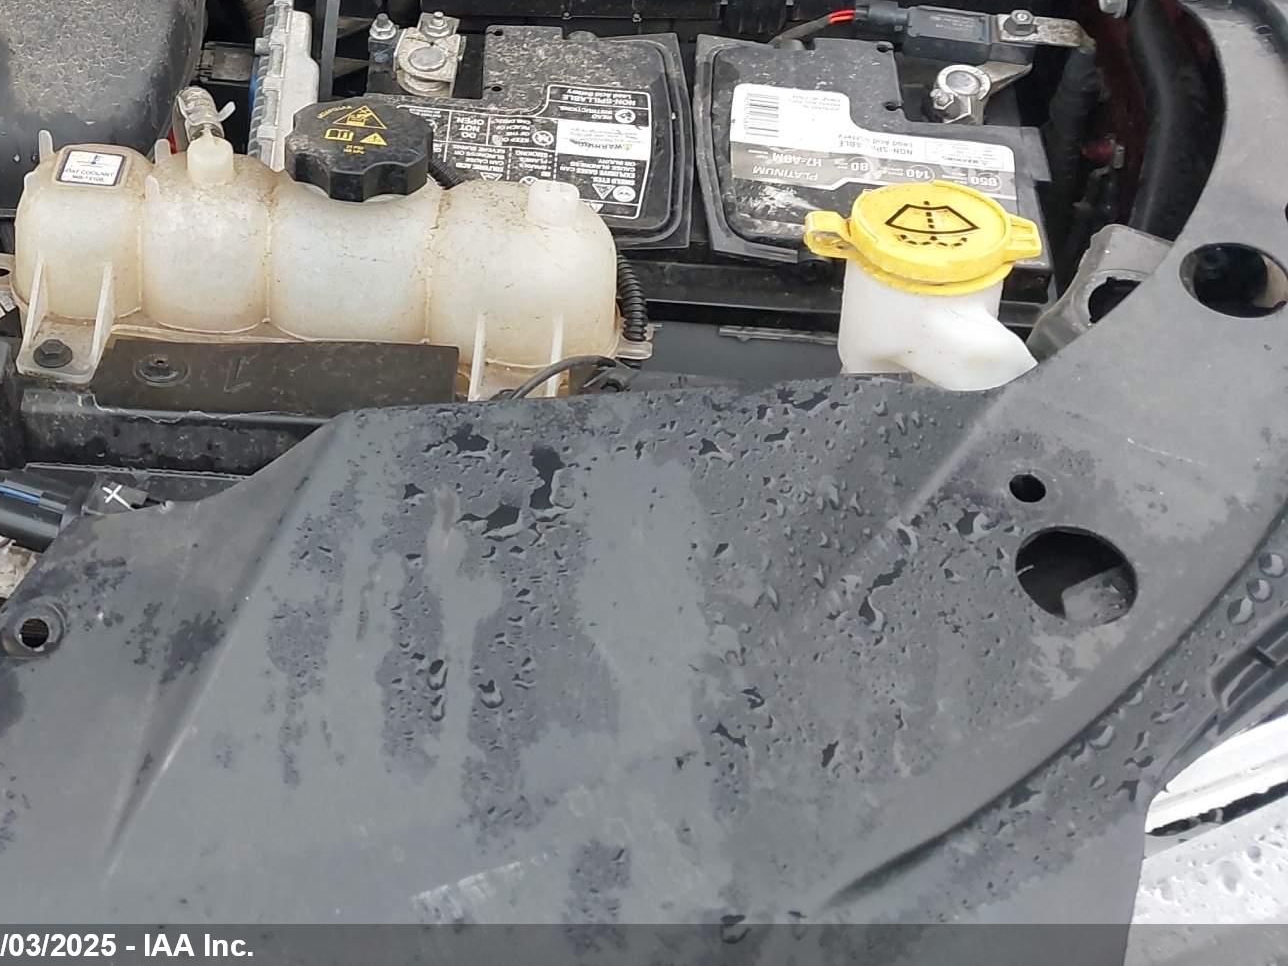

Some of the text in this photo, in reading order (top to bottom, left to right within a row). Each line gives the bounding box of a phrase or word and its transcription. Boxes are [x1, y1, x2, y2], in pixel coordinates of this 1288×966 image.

[562, 94, 635, 105] NON-SPILLABLE
[752, 166, 818, 180] PLATINUM
[851, 163, 868, 172] 80
[906, 169, 929, 180] 140
